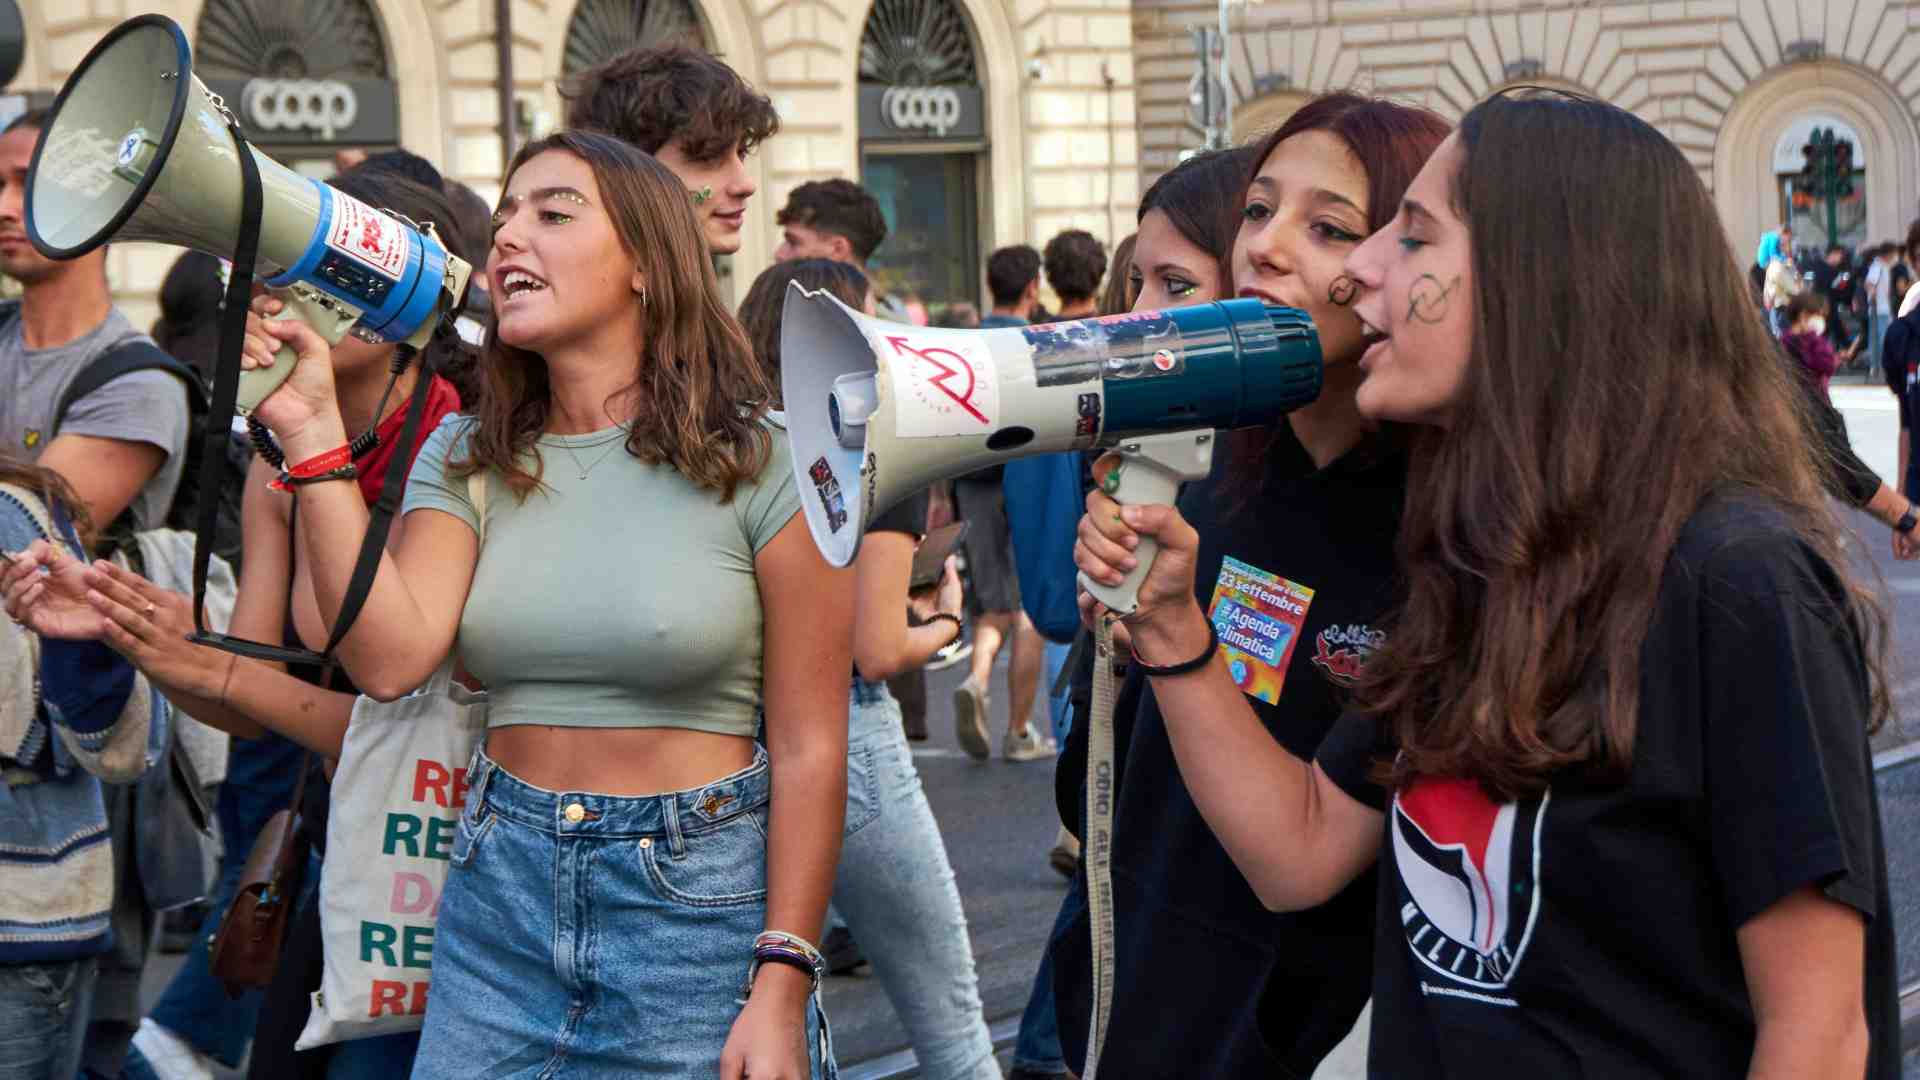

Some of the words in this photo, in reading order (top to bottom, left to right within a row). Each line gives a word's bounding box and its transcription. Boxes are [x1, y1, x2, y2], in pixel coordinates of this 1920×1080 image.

[242, 79, 357, 140] coop
[882, 86, 959, 137] coop
[1217, 572, 1235, 587] 23
[1234, 581, 1304, 615] settembre
[1216, 621, 1277, 661] Climatica
[1221, 605, 1281, 641] #Agenda
[389, 871, 444, 919] D
